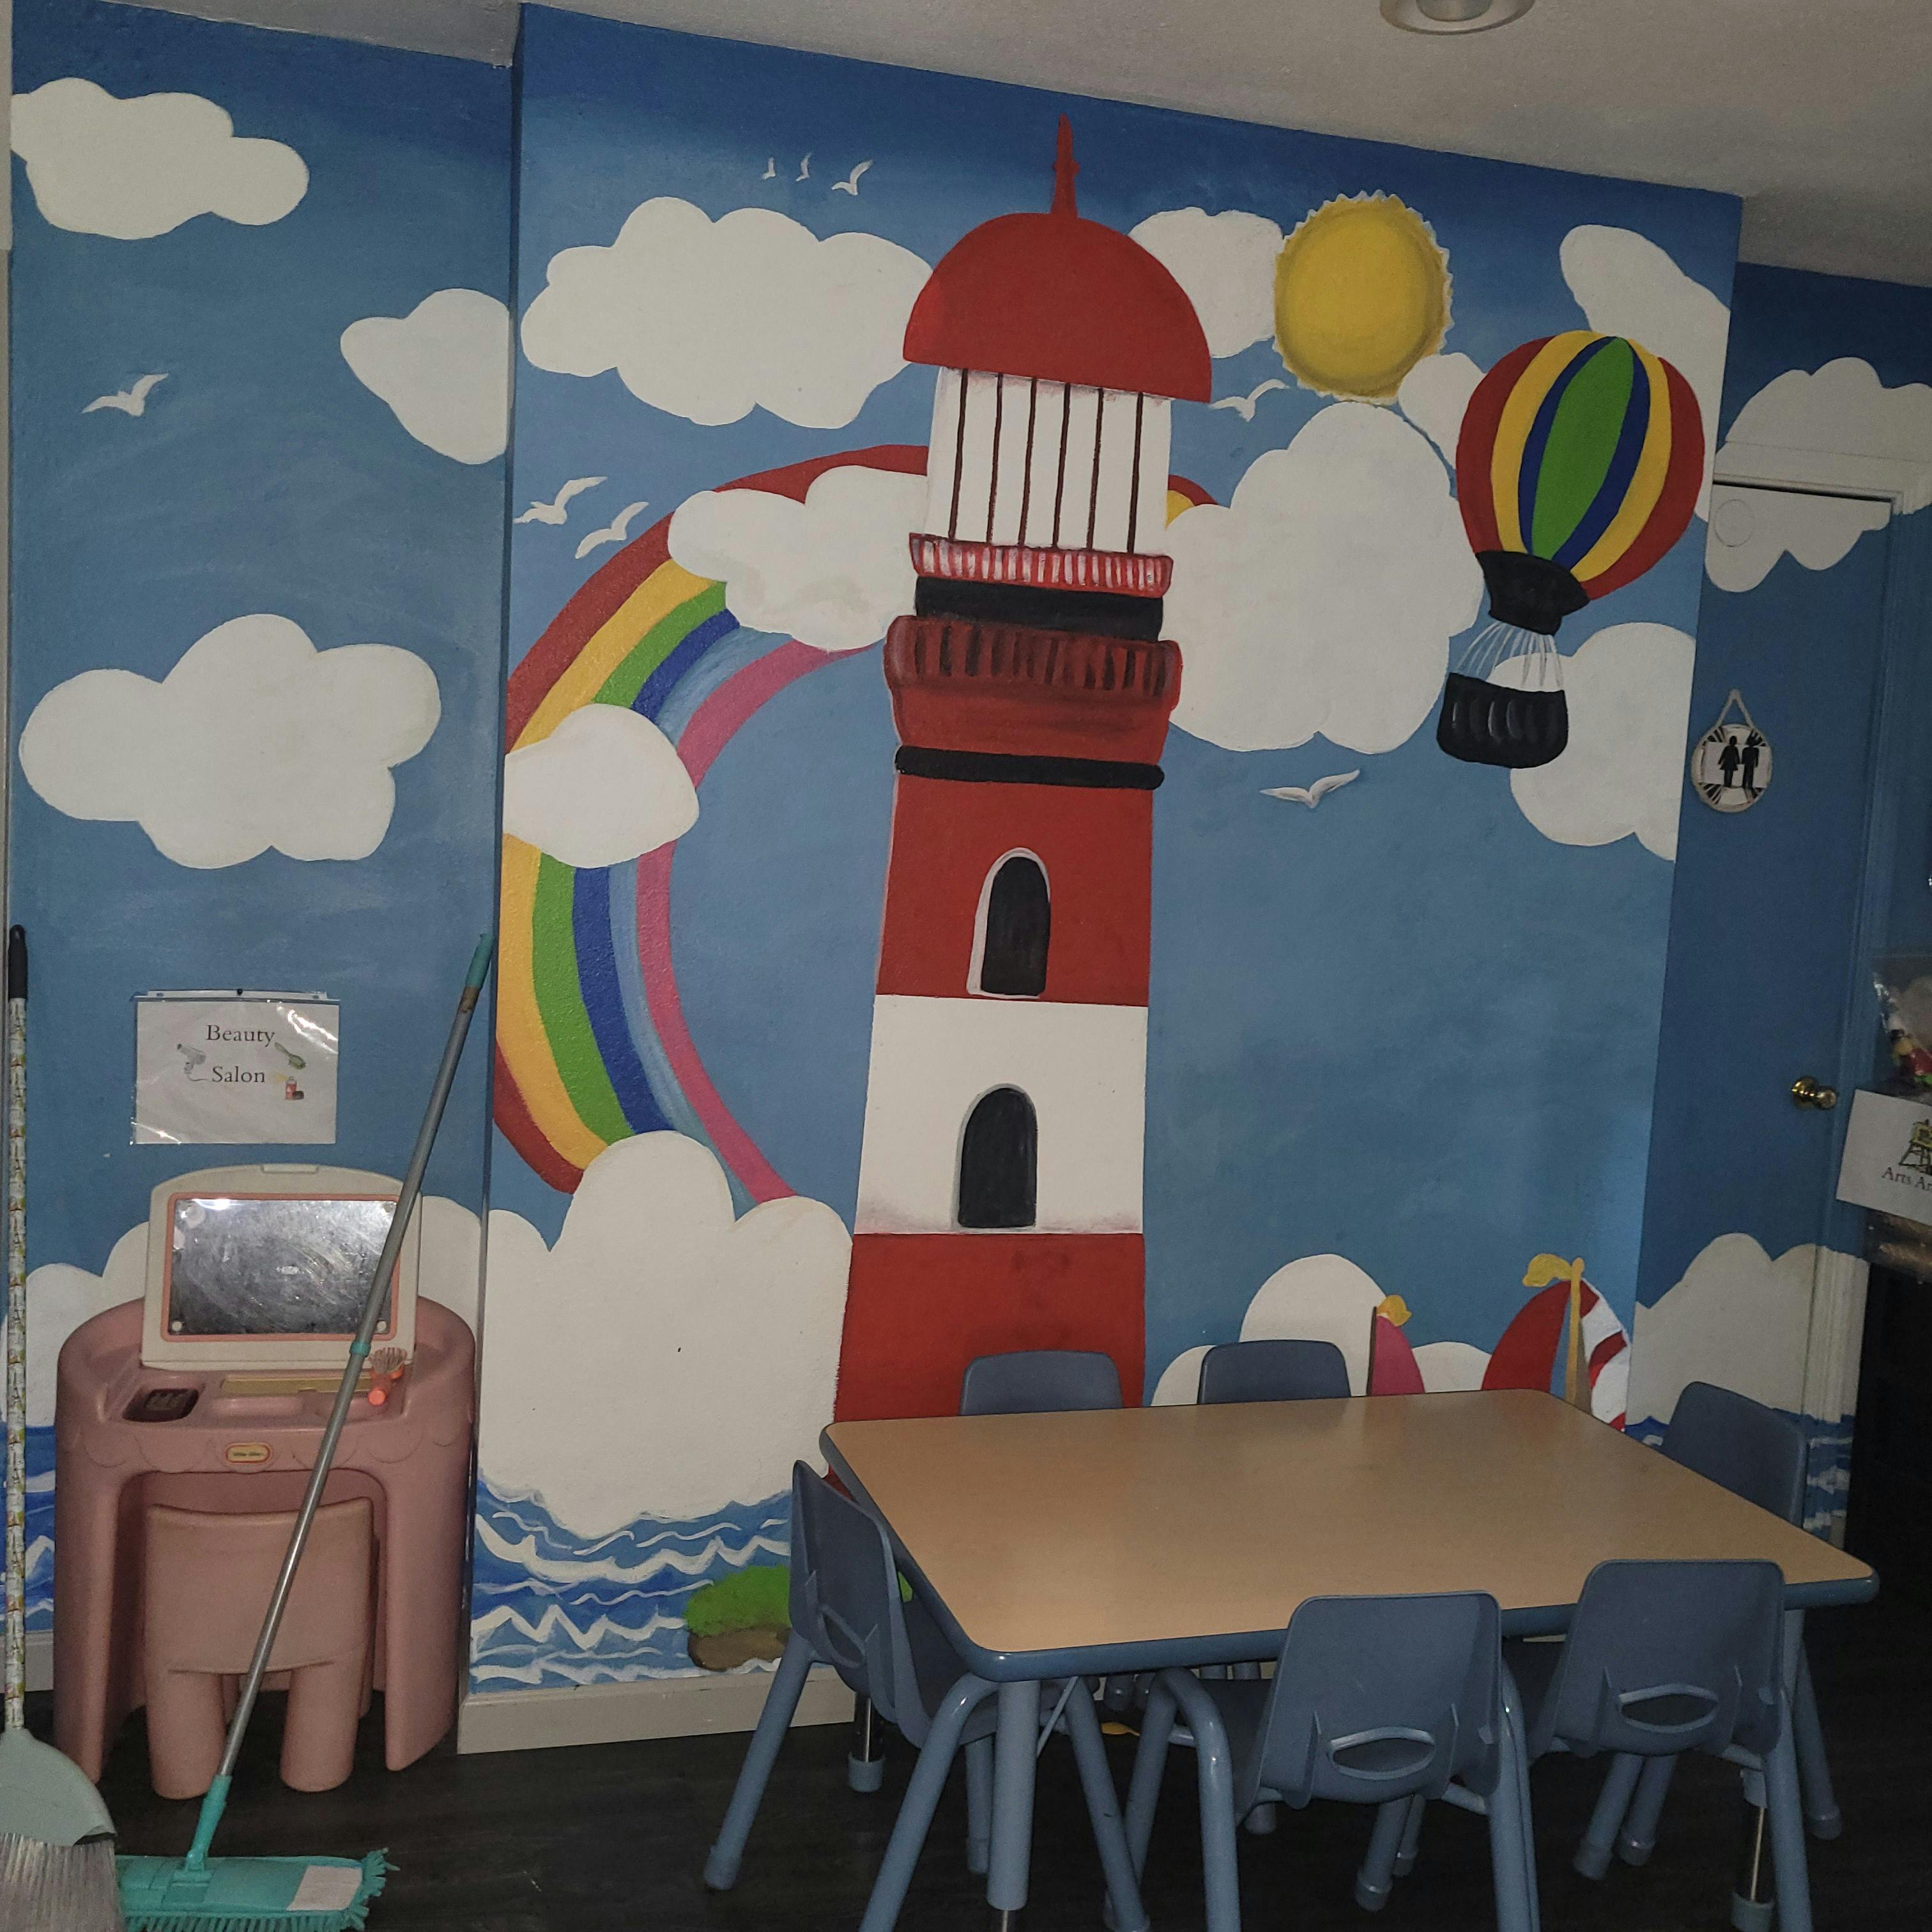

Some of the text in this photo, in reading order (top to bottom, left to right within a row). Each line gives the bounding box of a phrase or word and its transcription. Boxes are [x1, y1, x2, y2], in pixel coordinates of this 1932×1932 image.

[206, 1024, 275, 1047] Beauty
[211, 1066, 265, 1083] Salon
[1881, 1167, 1912, 1184] Arts
